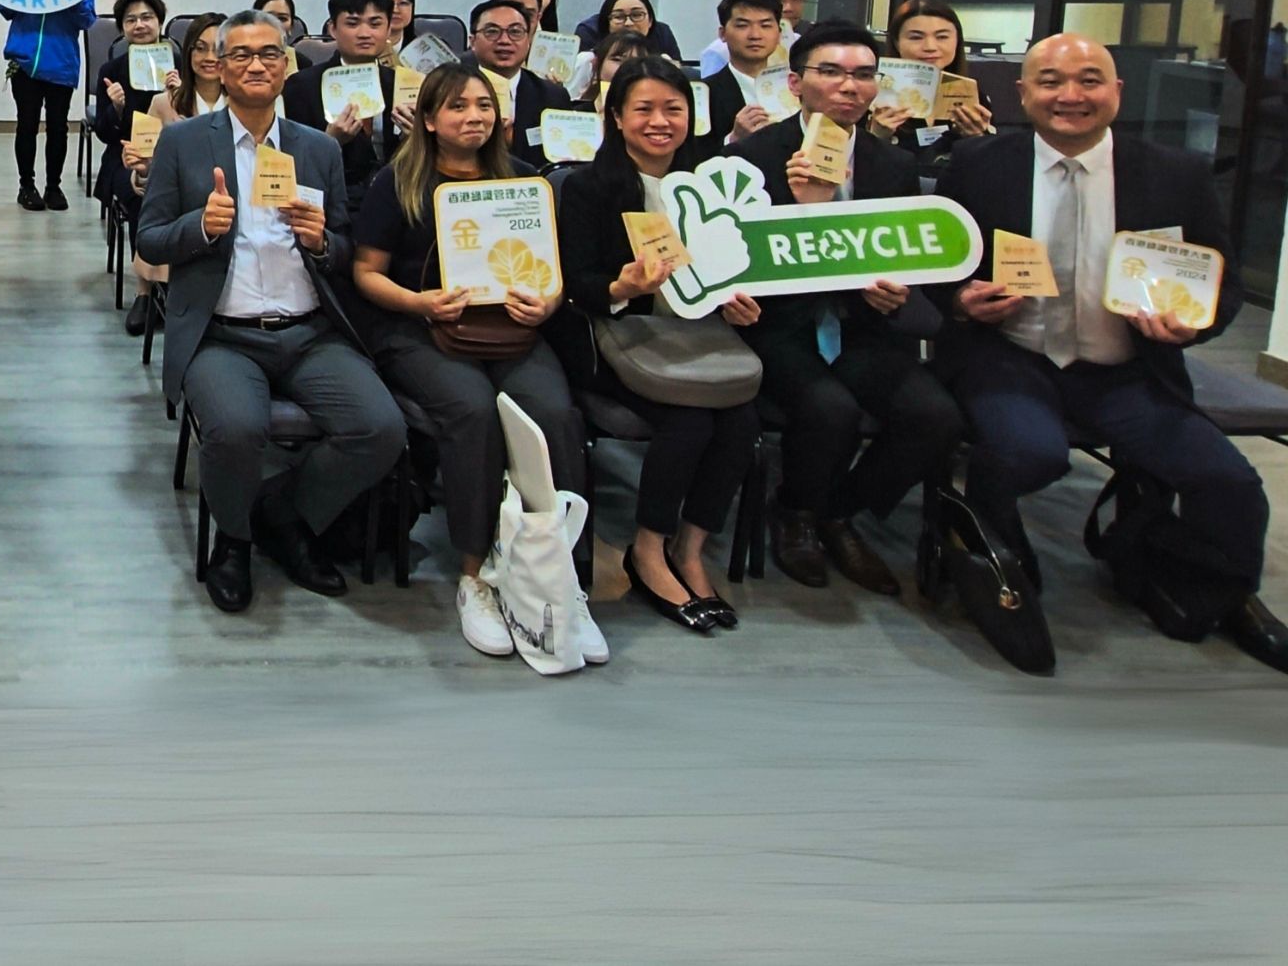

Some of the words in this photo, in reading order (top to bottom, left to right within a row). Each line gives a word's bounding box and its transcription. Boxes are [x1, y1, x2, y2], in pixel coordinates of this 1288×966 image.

[509, 218, 541, 230] 2024
[451, 218, 482, 251] 金
[1176, 269, 1207, 281] 2024
